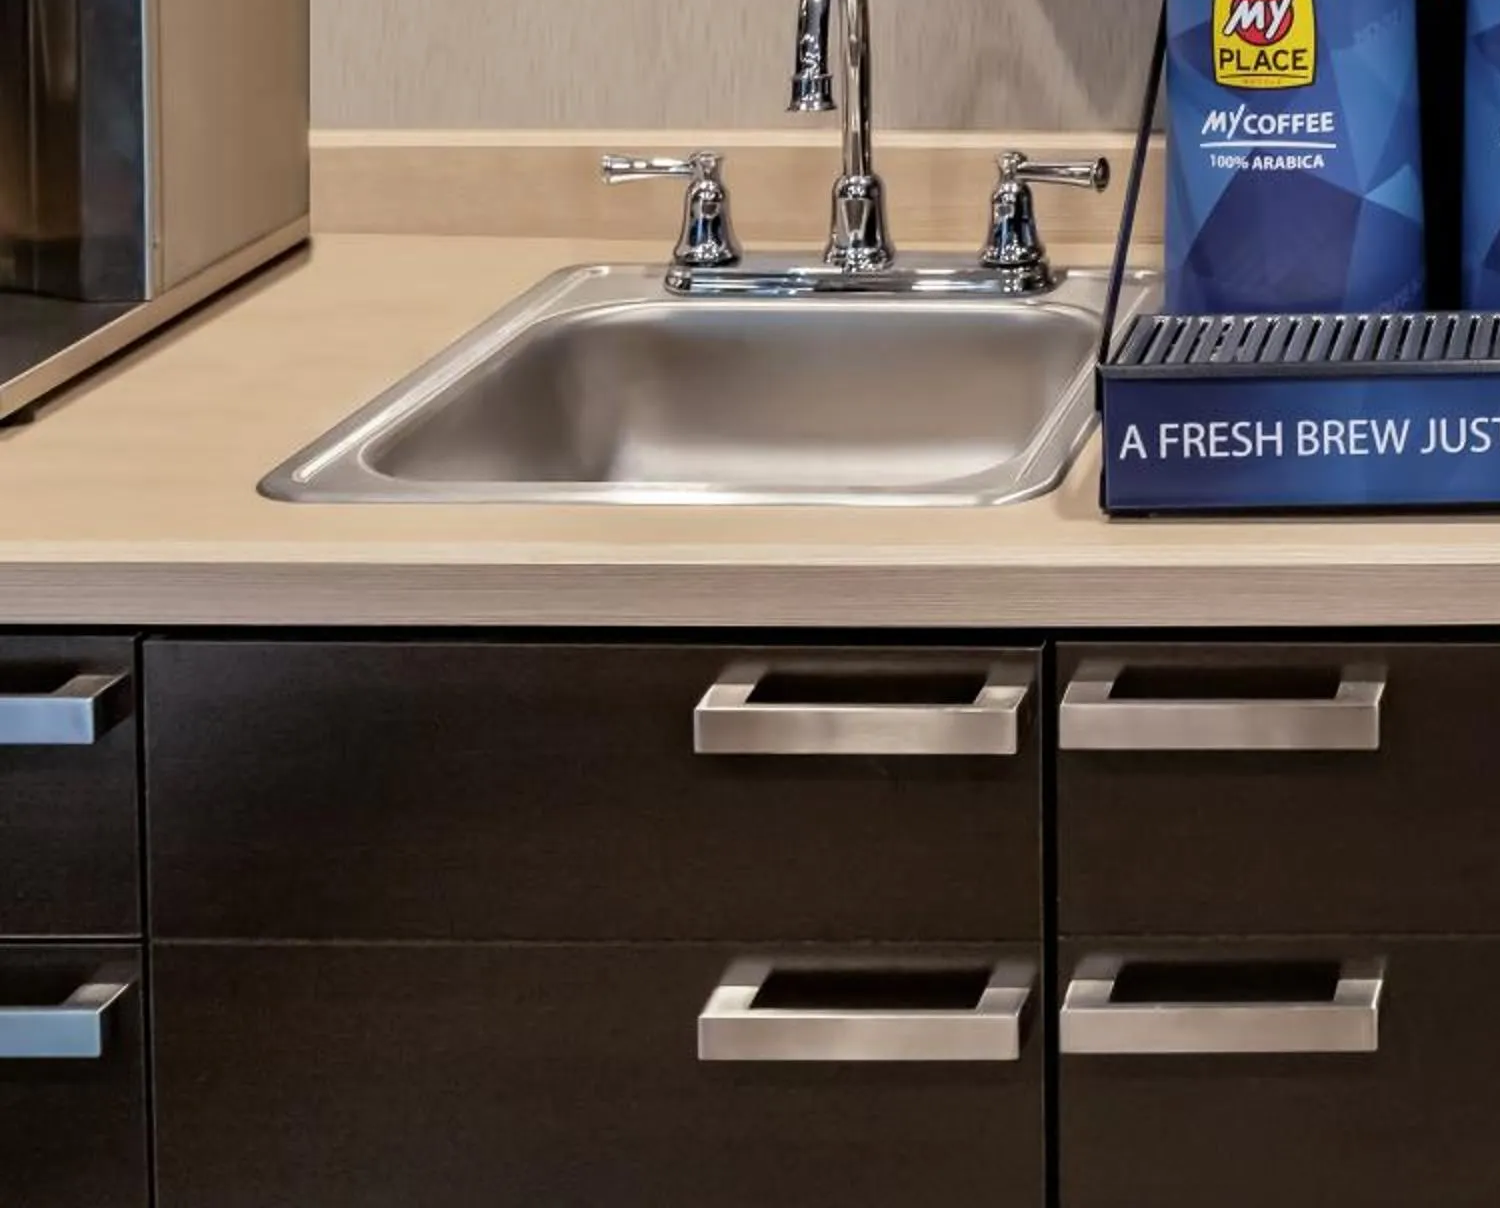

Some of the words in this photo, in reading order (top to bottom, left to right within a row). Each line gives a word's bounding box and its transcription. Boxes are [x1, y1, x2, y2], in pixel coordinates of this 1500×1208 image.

[1219, 48, 1309, 72] PLACE
[1210, 153, 1249, 170] 100%
[1251, 153, 1325, 171] ARABICA
[1119, 423, 1148, 460] A
[1159, 421, 1283, 459] FRESH
[1297, 419, 1410, 457] BREW
